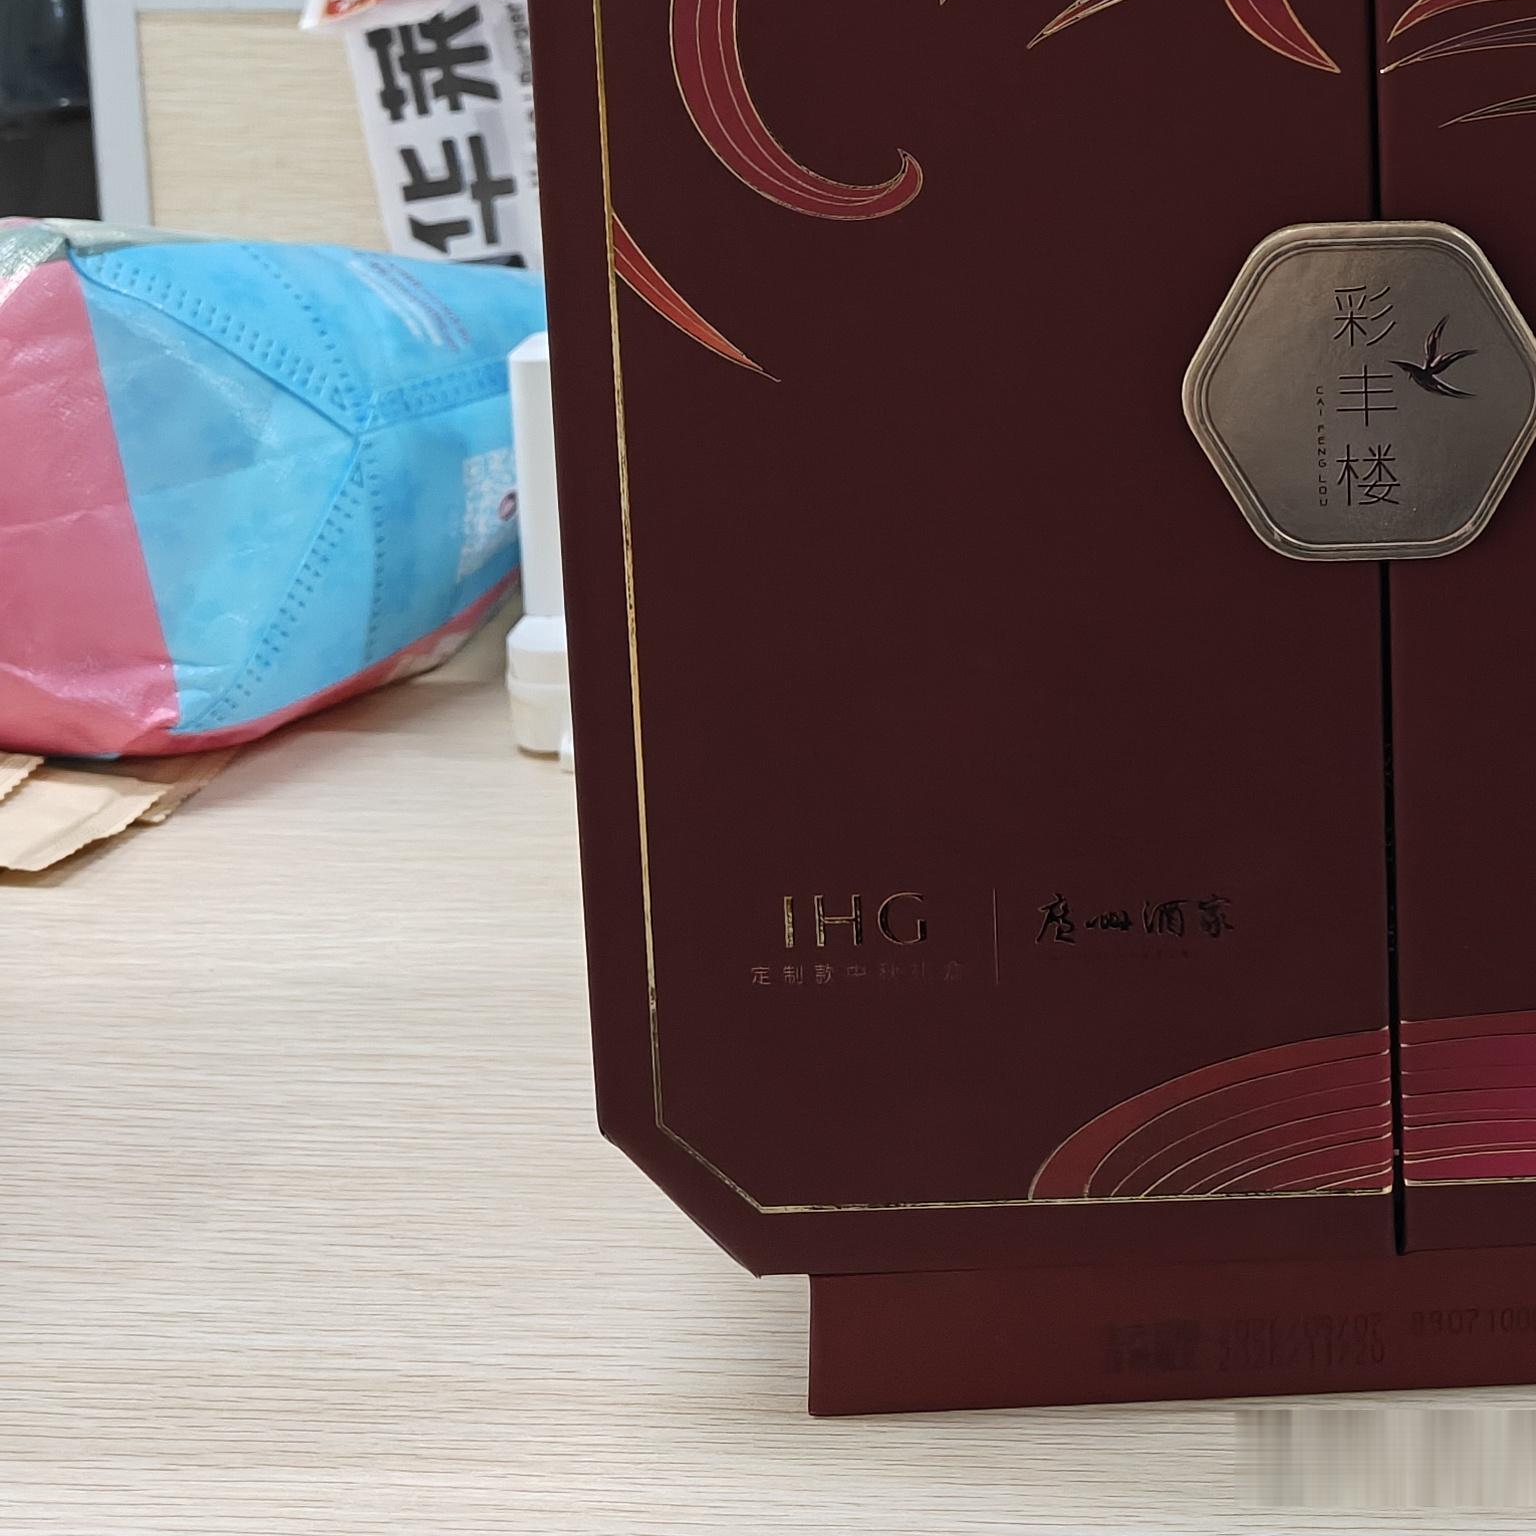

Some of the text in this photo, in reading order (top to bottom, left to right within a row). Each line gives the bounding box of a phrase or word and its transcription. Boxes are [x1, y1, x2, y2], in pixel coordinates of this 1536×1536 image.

[1333, 285, 1401, 506] 彩丰楼
[783, 891, 928, 949] IHG
